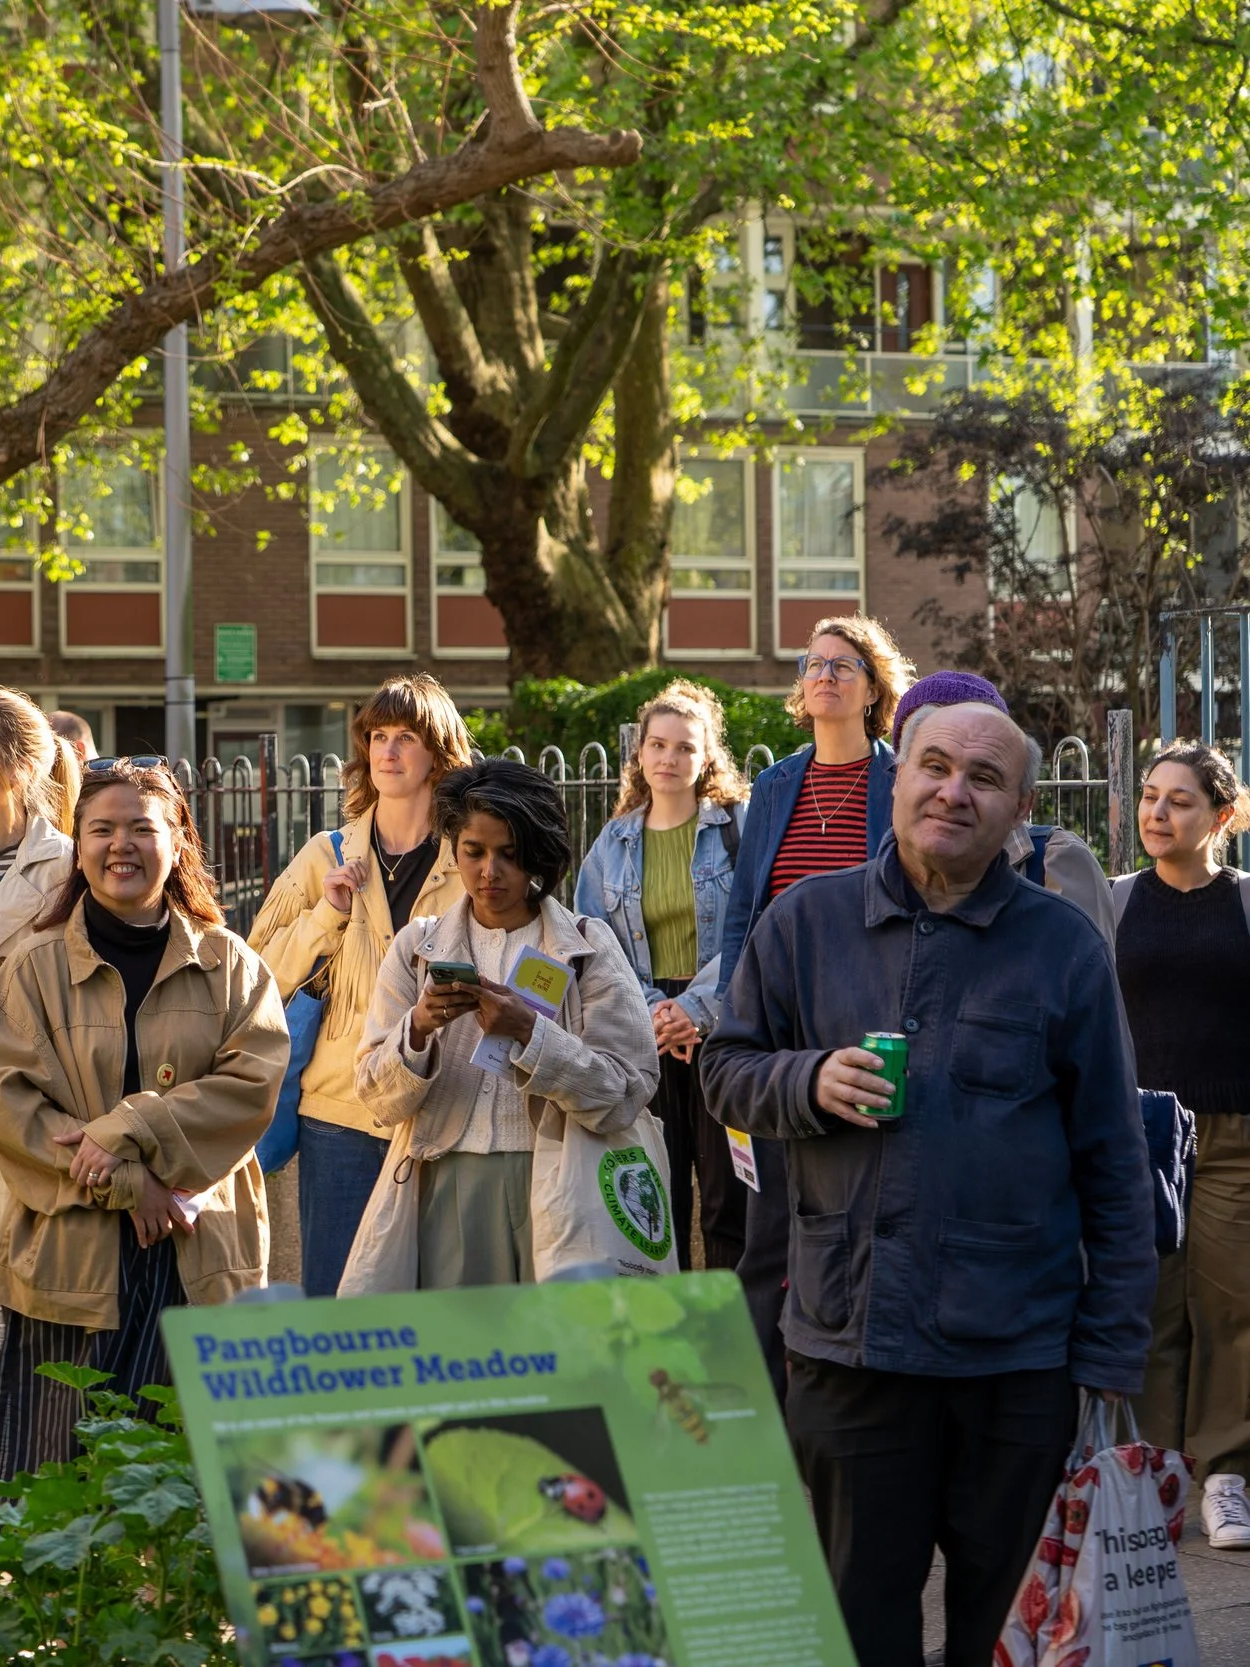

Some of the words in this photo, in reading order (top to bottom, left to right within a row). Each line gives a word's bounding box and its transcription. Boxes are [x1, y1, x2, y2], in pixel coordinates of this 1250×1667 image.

[603, 1151, 637, 1174] SOERS
[604, 1184, 638, 1240] CLIMATE
[193, 1326, 418, 1367] Pangbourne
[202, 1363, 404, 1401] Wildflower
[411, 1349, 558, 1385] Meadow
[1104, 1572, 1119, 1591] a
[1125, 1560, 1176, 1590] keepe
